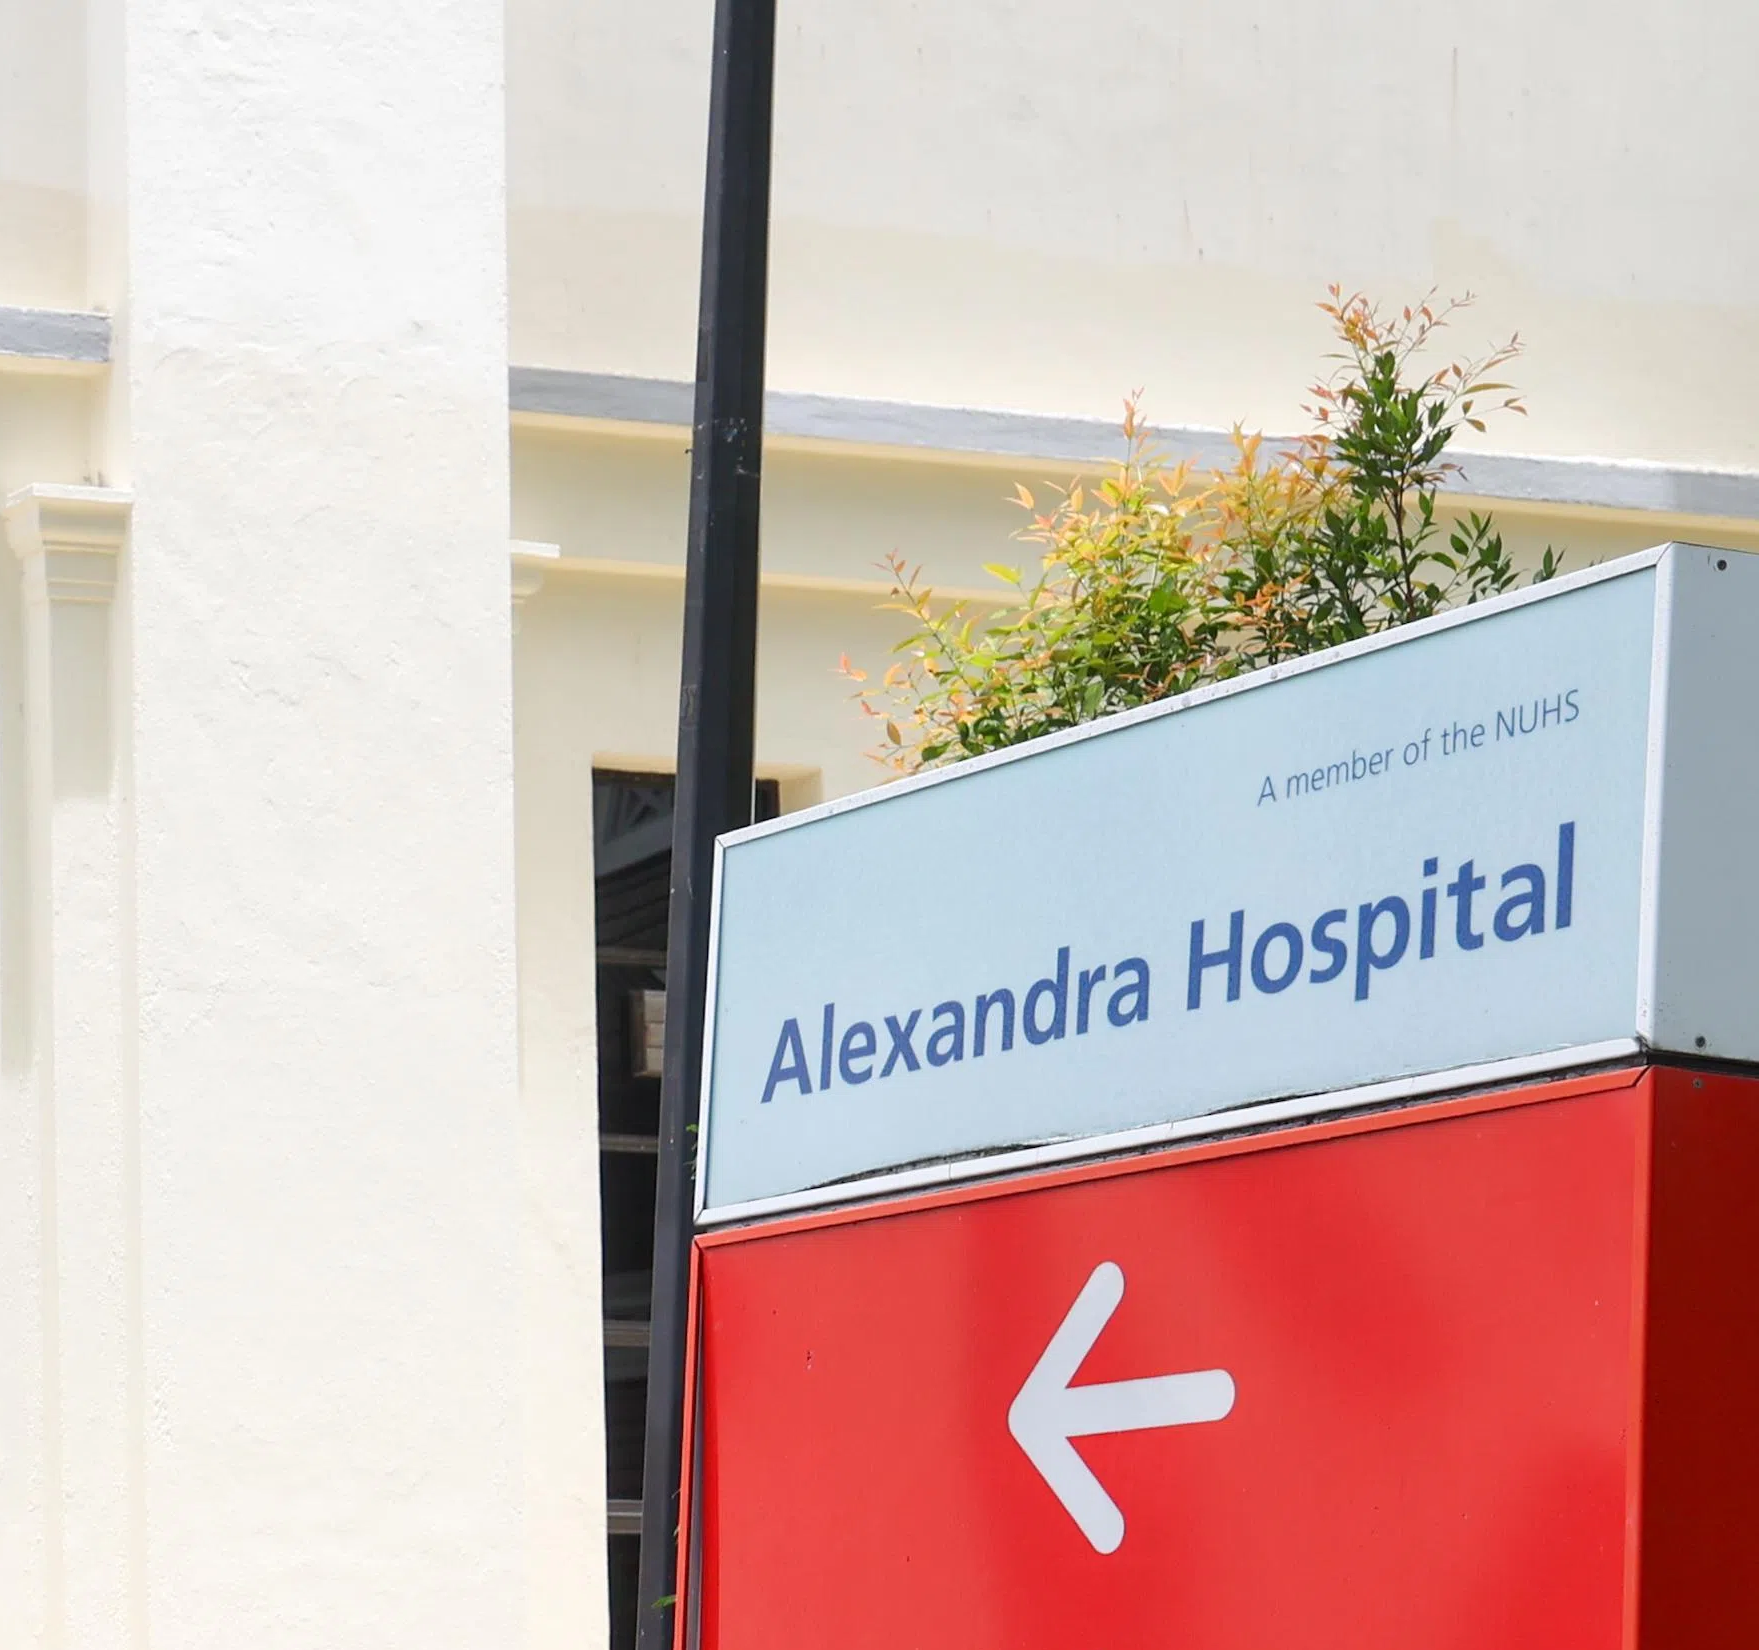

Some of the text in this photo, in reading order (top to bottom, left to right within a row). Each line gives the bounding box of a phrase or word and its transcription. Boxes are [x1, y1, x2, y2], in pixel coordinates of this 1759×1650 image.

[1257, 689, 1580, 806] A member of the NUHS
[760, 822, 1577, 1104] Alexandra Hospital
